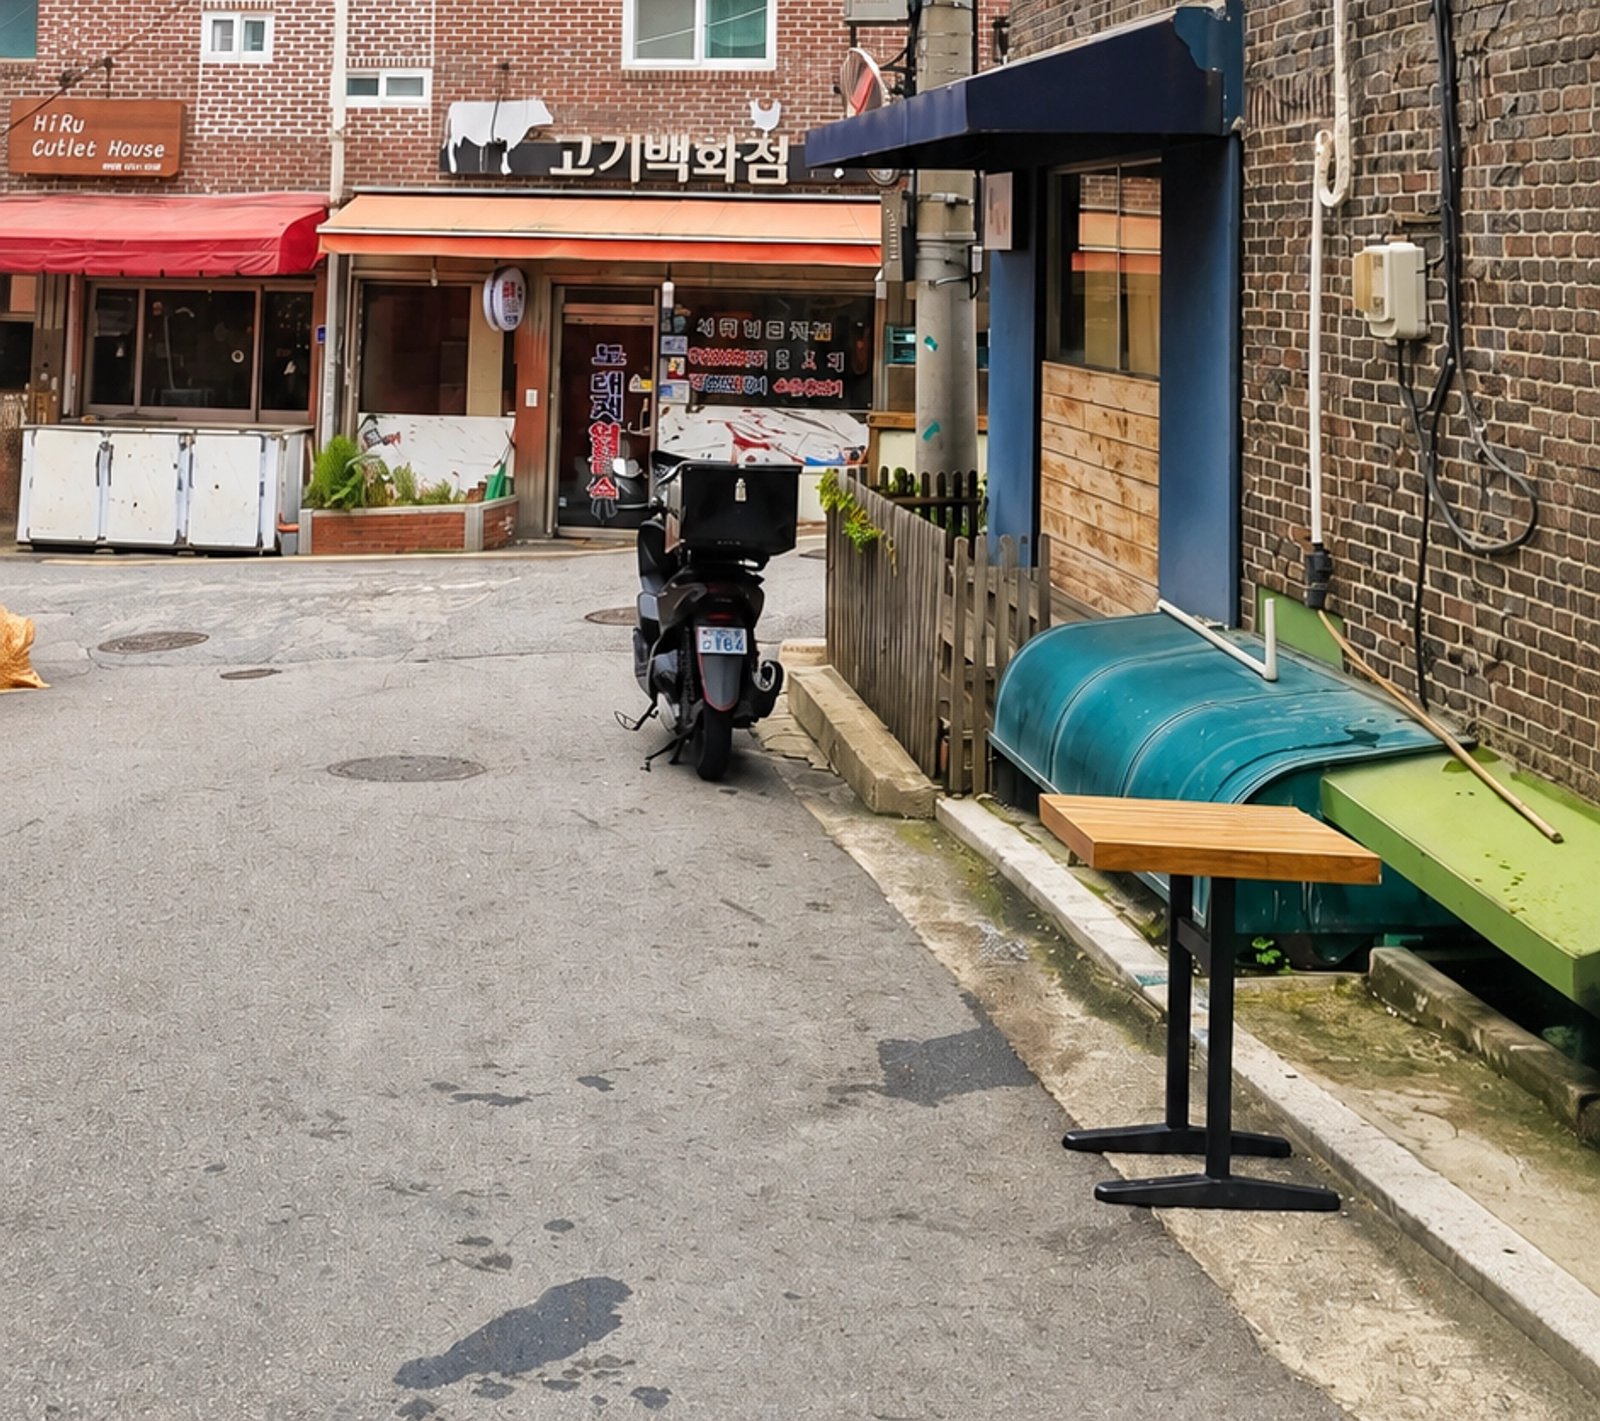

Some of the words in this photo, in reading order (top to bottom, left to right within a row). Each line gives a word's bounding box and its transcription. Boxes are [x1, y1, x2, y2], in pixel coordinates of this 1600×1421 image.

[33, 113, 85, 134] HiRu
[32, 138, 97, 158] Cutlet
[107, 139, 165, 158] House
[549, 133, 790, 186] 고기백화점
